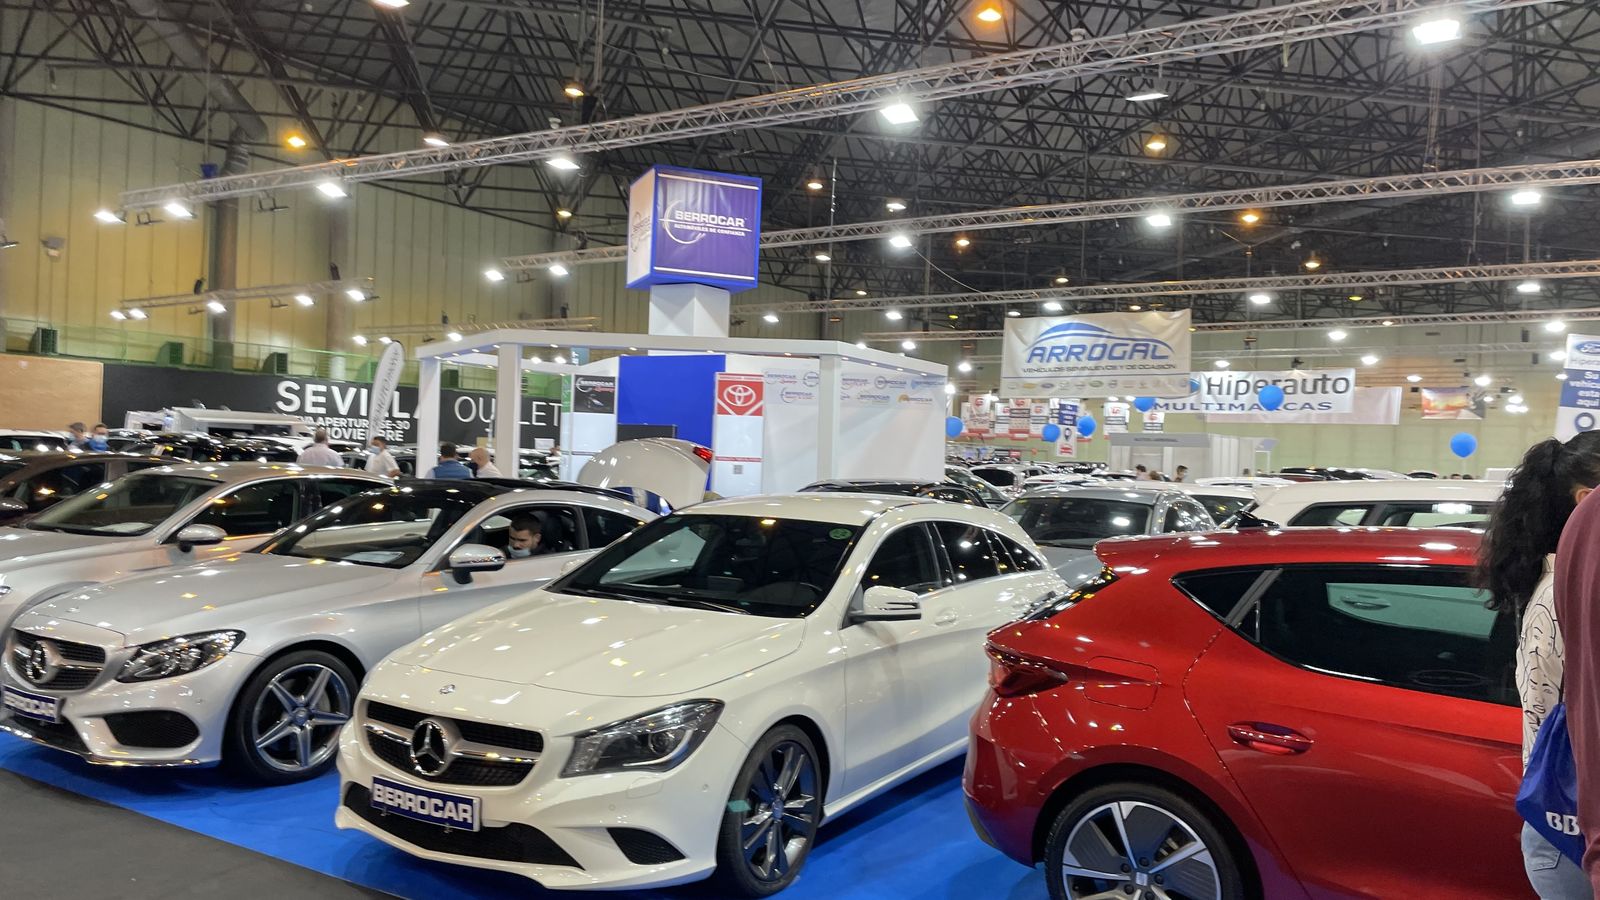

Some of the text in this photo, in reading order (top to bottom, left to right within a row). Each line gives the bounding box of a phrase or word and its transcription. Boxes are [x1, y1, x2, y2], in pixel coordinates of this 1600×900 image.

[675, 209, 745, 227] BERROCAR
[1026, 342, 1169, 363] ARROGAL
[276, 380, 419, 419] SEVIL
[454, 395, 563, 427] OUET
[1153, 402, 1332, 411] MULTIMACAS
[318, 416, 370, 429] APERTUR
[4, 690, 56, 717] BERROCAR
[373, 783, 473, 823] BERROCAR
[1546, 811, 1580, 836] BB
